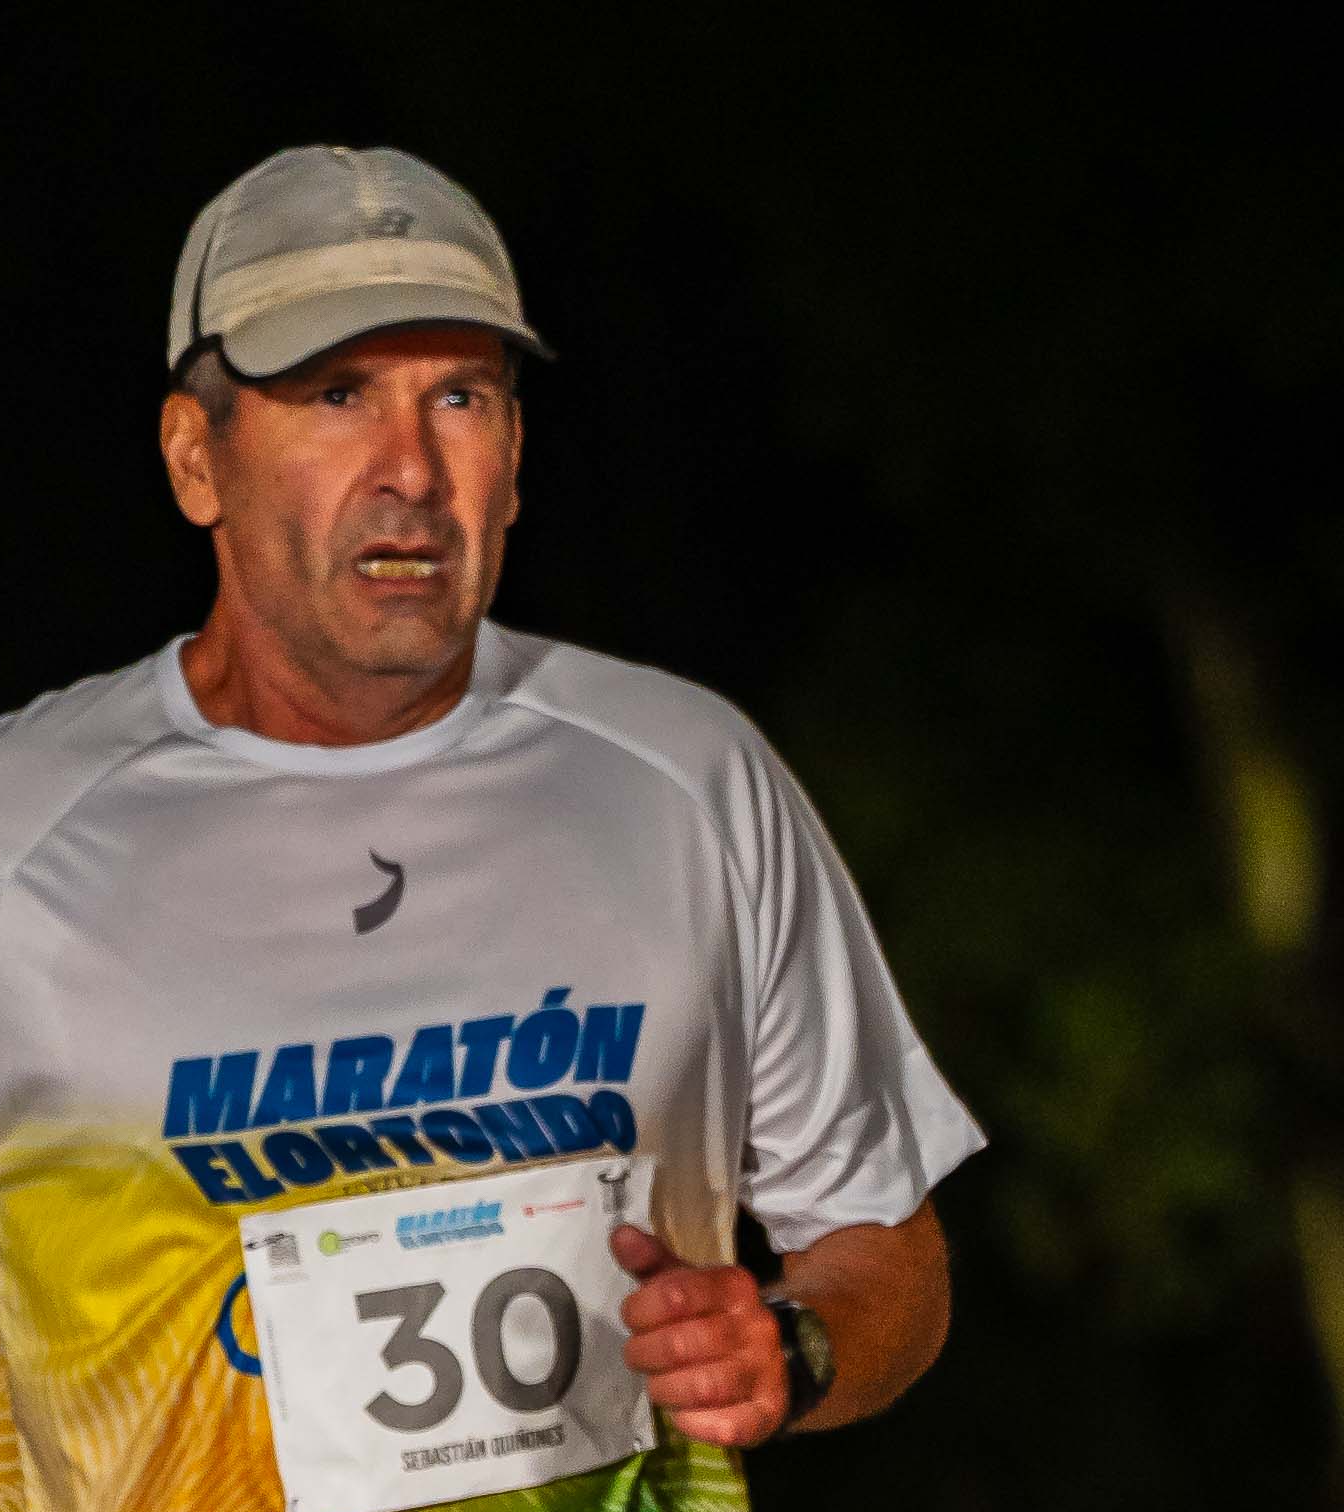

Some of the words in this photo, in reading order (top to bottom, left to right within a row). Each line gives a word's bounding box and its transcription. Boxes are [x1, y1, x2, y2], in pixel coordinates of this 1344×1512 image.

[162, 986, 646, 1140] MARATÓN
[170, 1090, 638, 1206] ELORTONDO
[355, 1268, 582, 1433] 30
